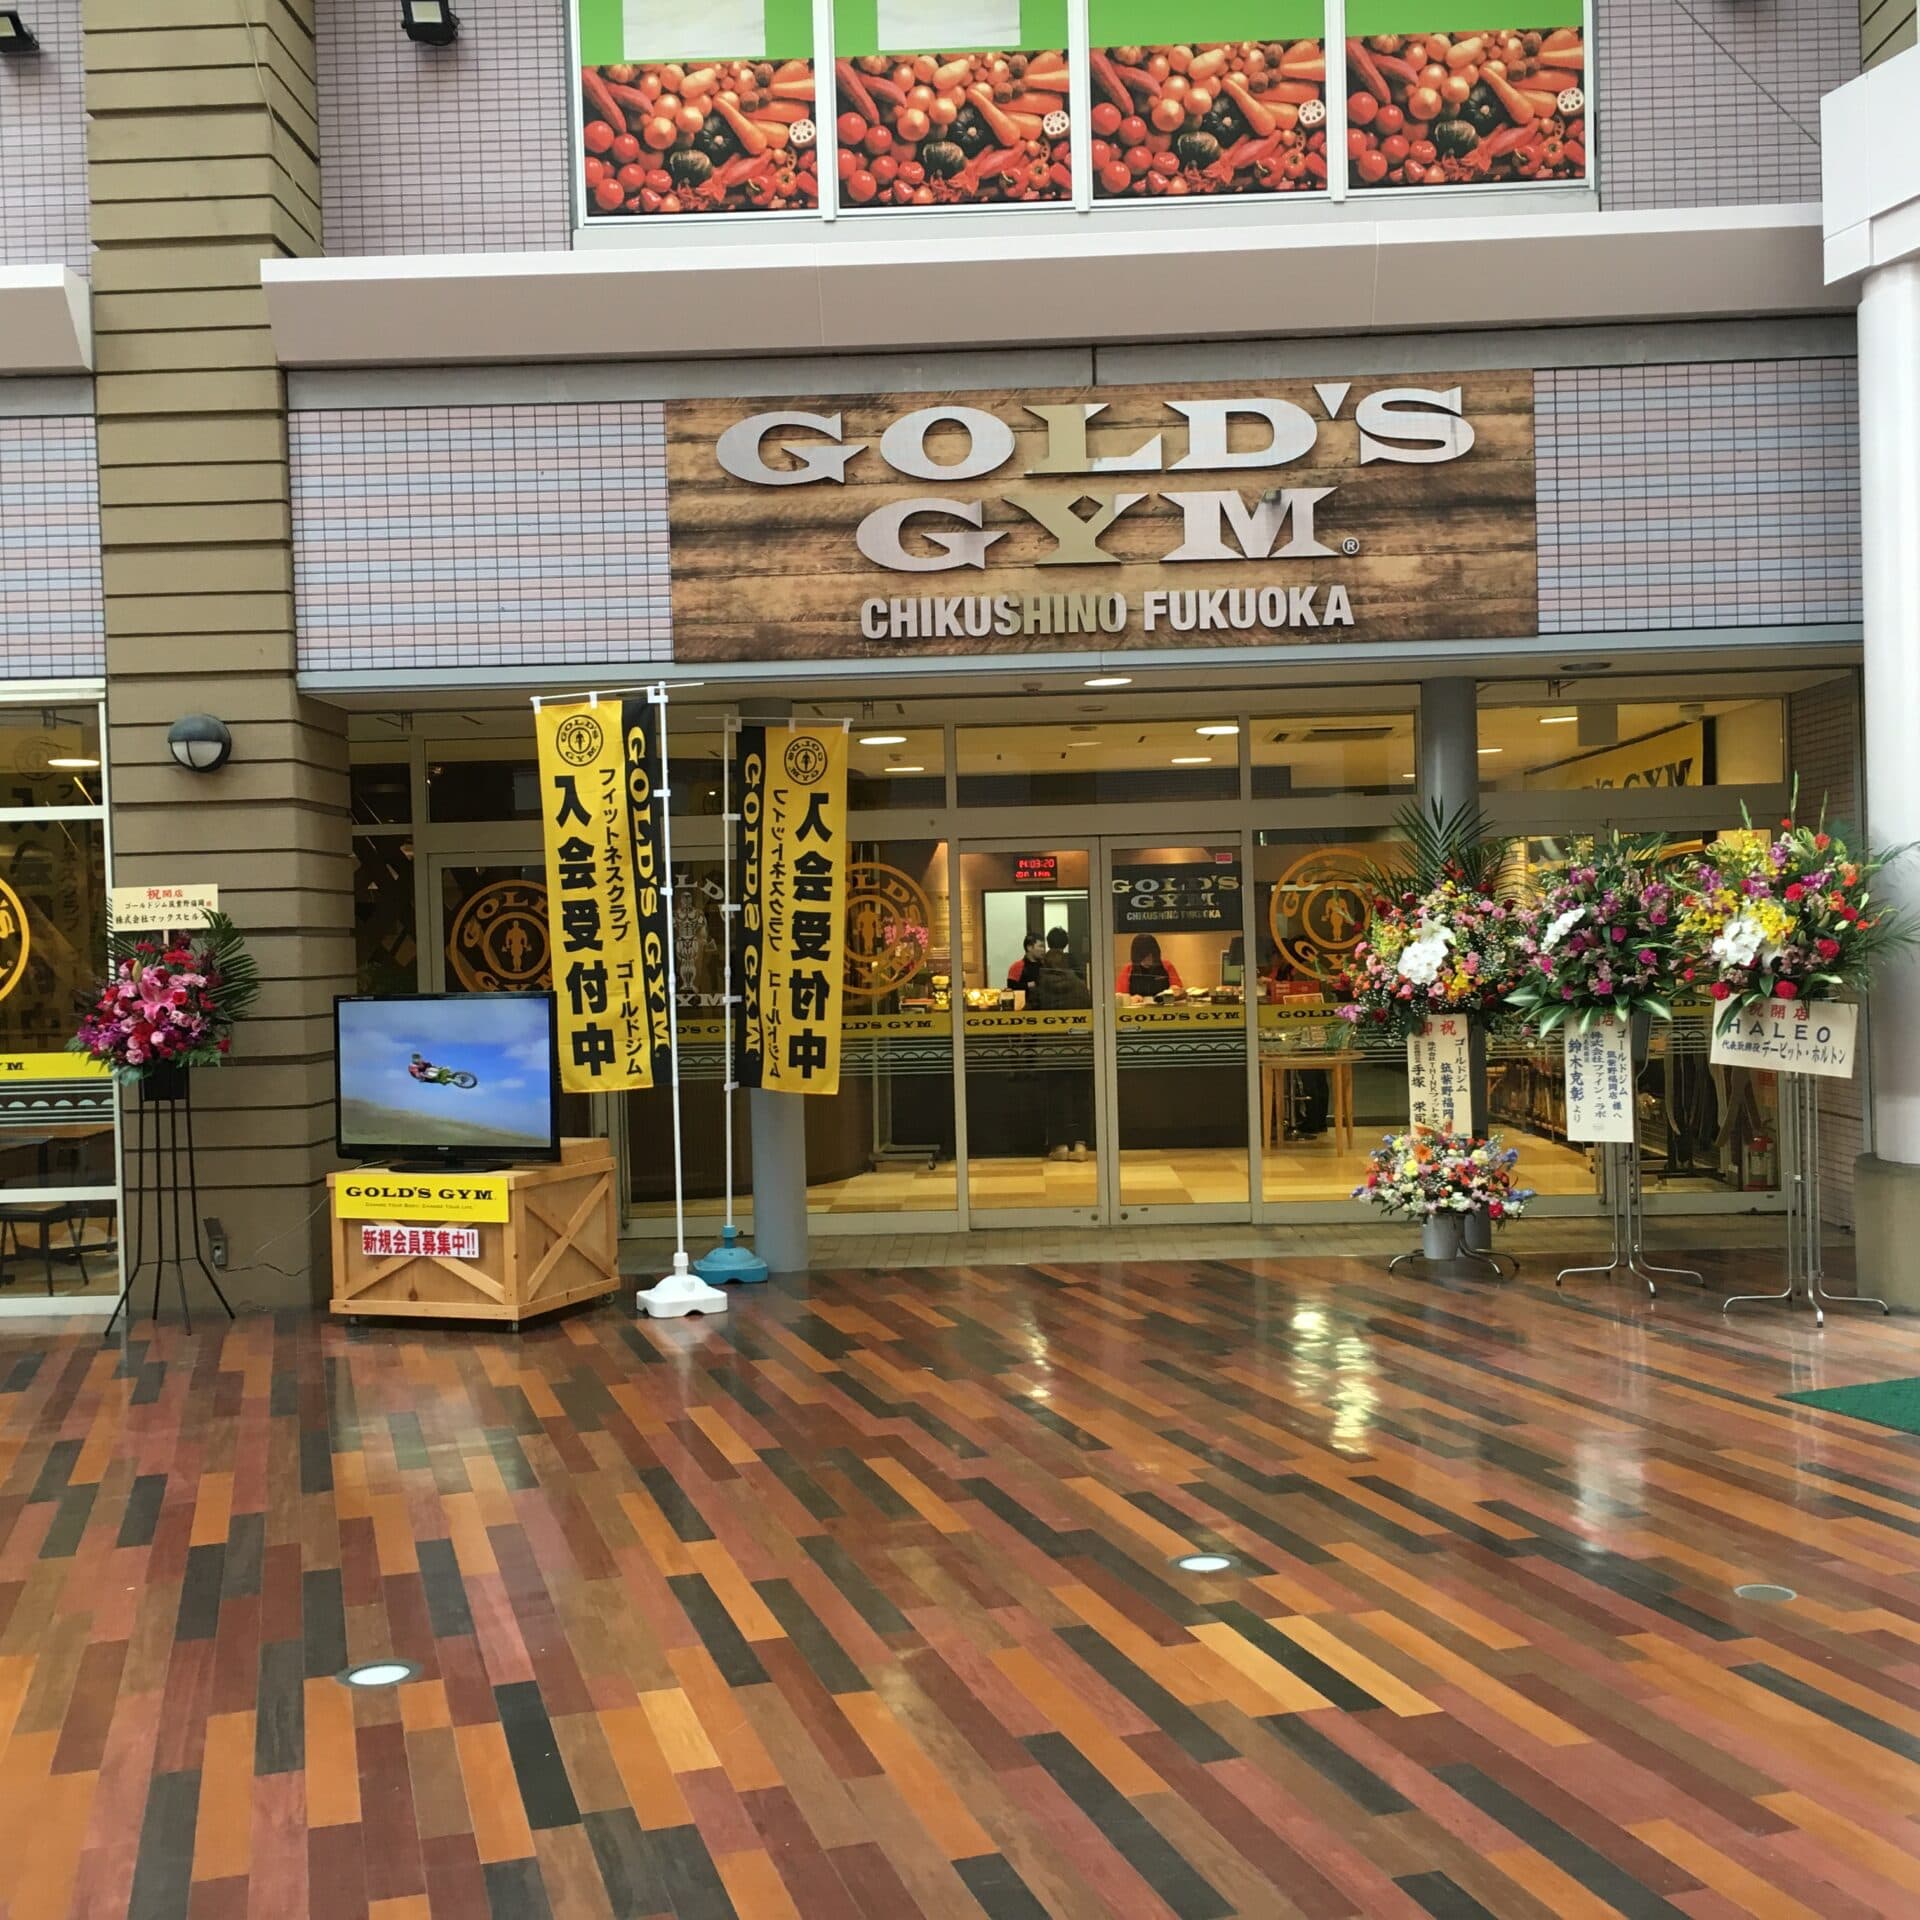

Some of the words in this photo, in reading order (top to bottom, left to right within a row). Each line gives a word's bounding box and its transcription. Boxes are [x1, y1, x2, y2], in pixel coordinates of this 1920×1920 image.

[715, 382, 1476, 486] GOLD'S
[856, 486, 1339, 572] GYM
[860, 592, 1128, 641] CHIKUSHINO
[1143, 584, 1356, 632] FUKUOKA
[626, 725, 660, 919] GOLD'S
[553, 774, 617, 1077] 入会受付中
[598, 768, 632, 943] フィットネスクラブ
[615, 958, 644, 1075] ゴールドジム
[641, 930, 671, 1054] GYM
[966, 1016, 1038, 1027] GOLD'S
[1043, 1015, 1088, 1025] GYM
[1118, 1012, 1190, 1023] GOLD'S
[1195, 1010, 1241, 1022] GYM
[1727, 1018, 1831, 1043] HALEO
[1454, 1036, 1468, 1093] ゴールドジム
[1616, 1028, 1628, 1096] ゴールドジム
[345, 1186, 432, 1199] GOLD'S
[438, 1188, 494, 1201] GYM
[363, 1228, 476, 1256] 新規会員募集中!!
